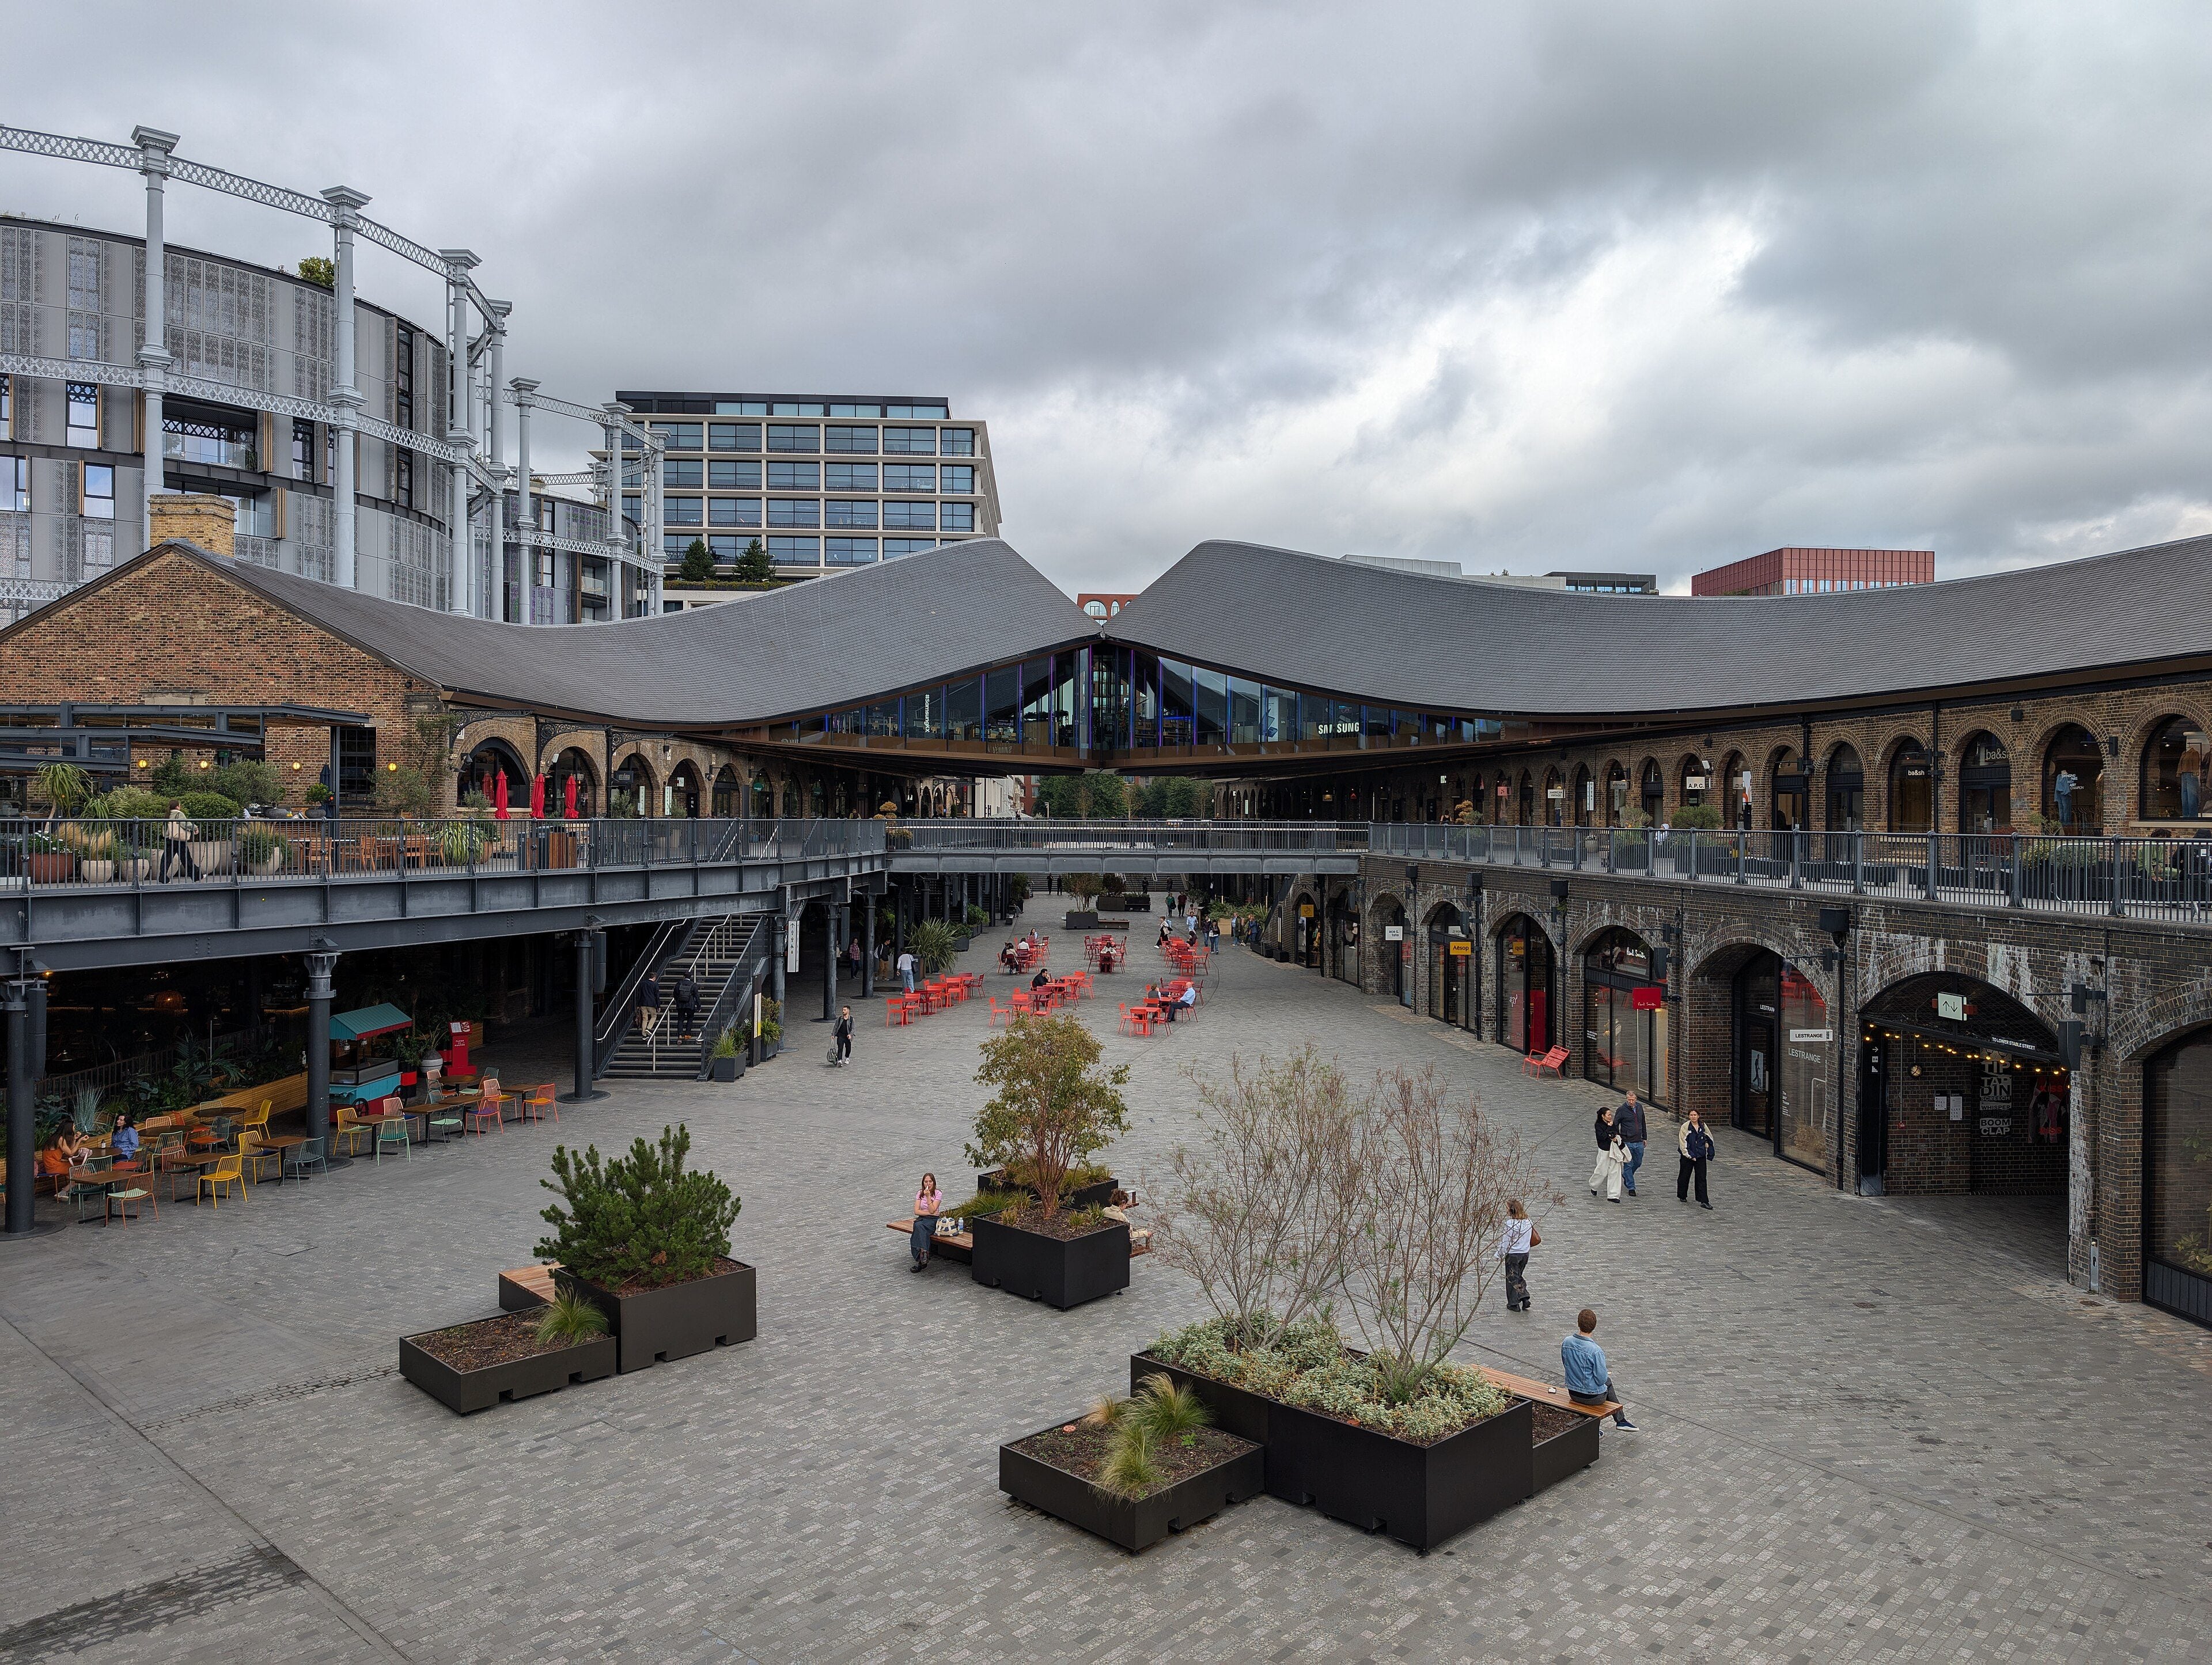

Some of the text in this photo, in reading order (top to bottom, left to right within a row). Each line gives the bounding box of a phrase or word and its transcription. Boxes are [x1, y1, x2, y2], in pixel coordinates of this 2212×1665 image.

[1986, 749, 2009, 760] ba&s
[1626, 947, 1646, 959] Paul Smith
[1788, 1048, 1821, 1063] LESTRANGE
[1981, 1127, 2010, 1135] CLAP
